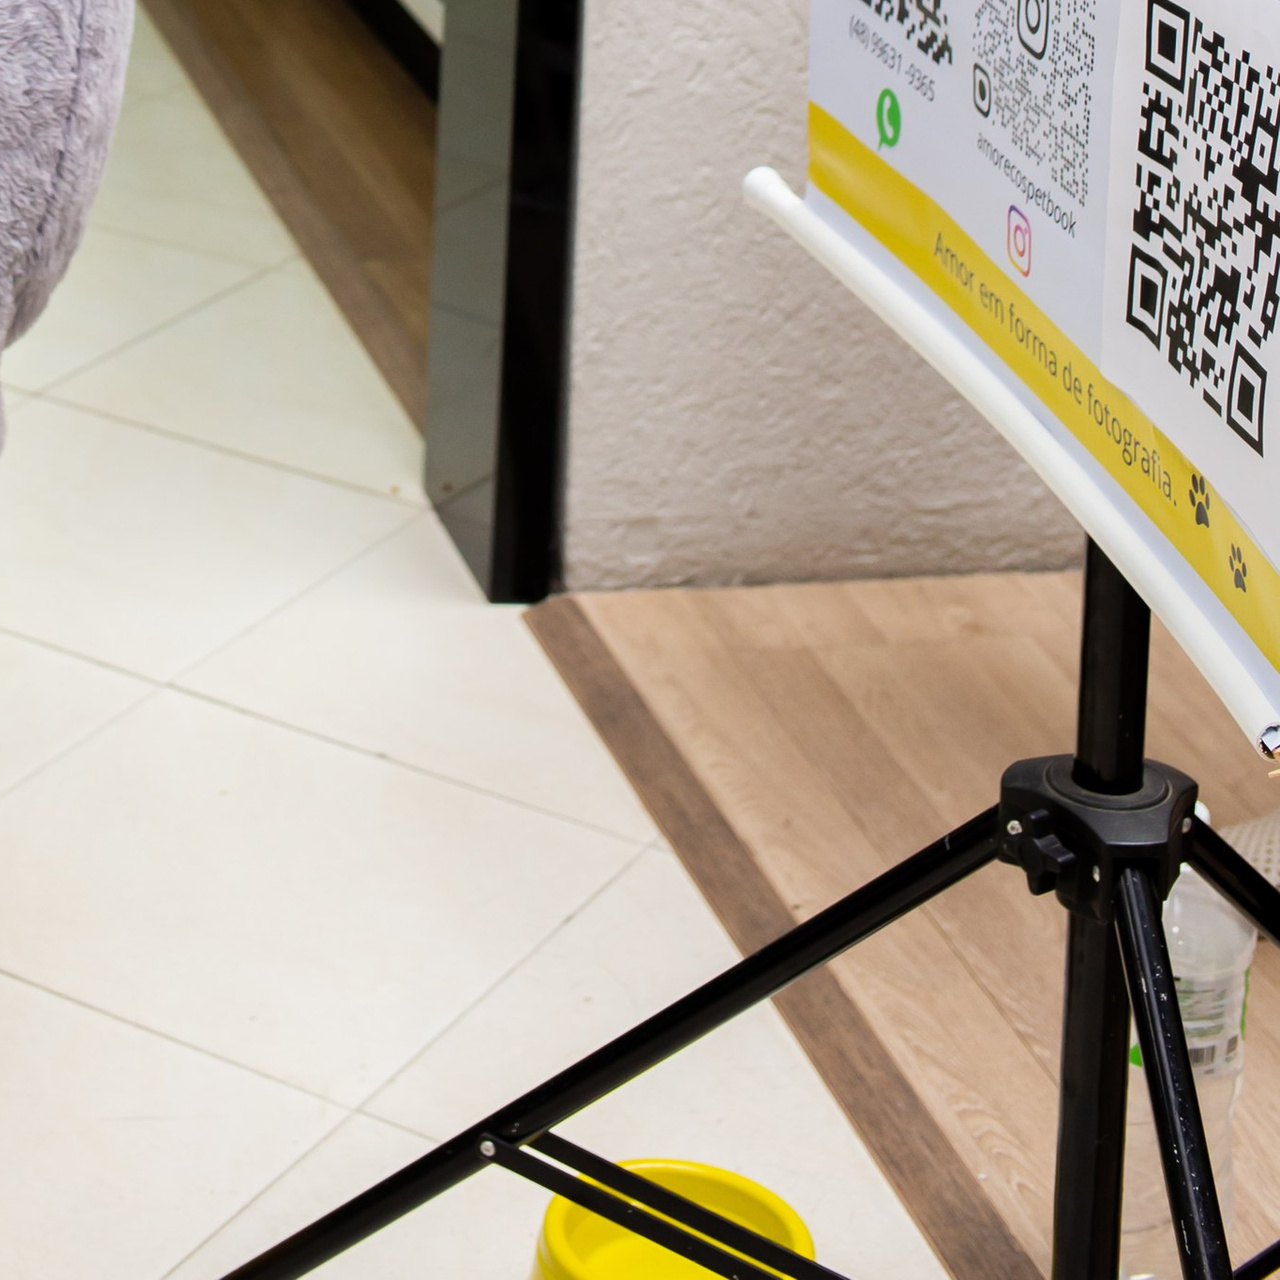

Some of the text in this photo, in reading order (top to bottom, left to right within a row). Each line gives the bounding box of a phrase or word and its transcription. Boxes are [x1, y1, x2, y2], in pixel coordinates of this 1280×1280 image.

[977, 131, 1077, 239] amorecospetbook
[934, 232, 1178, 507] Amor em forma de fotografia.
